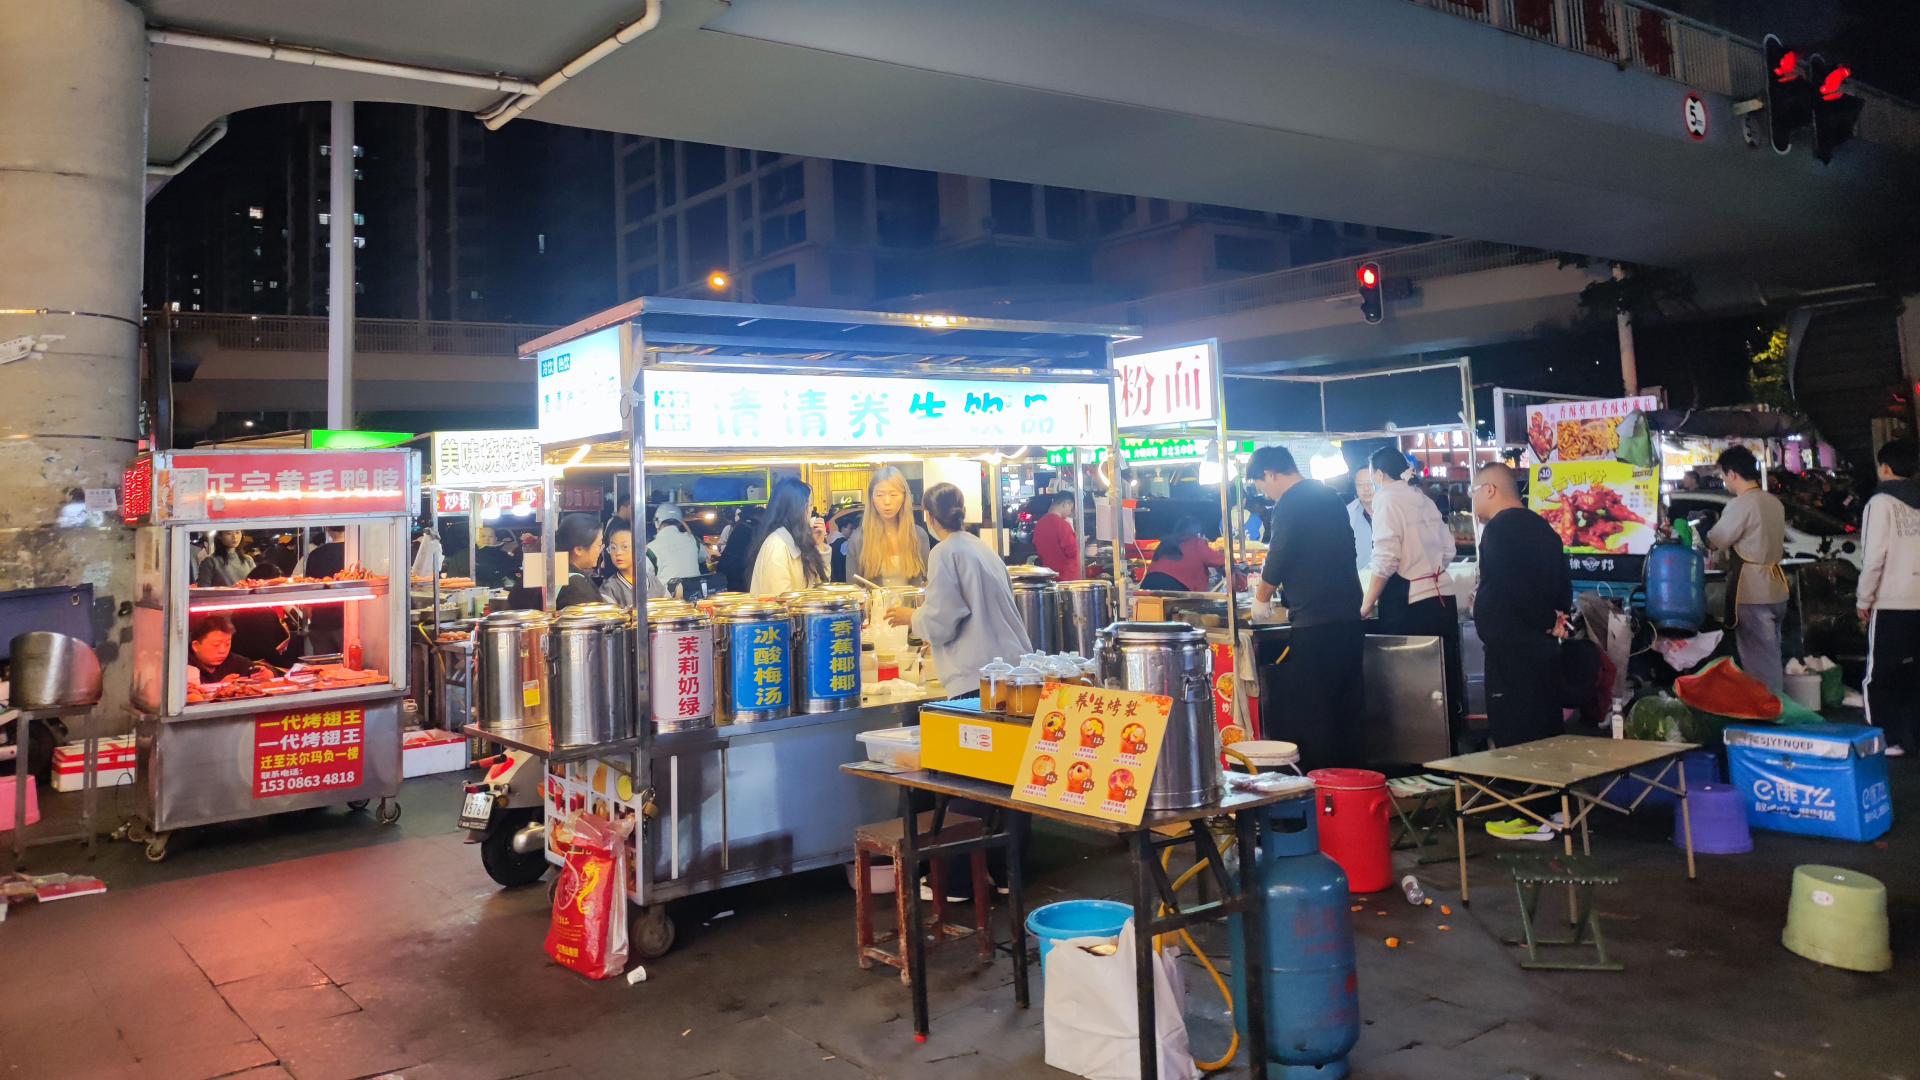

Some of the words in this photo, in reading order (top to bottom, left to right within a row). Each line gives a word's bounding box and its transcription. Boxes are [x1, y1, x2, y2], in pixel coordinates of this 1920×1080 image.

[753, 625, 783, 706] 冰酸梅汤
[829, 619, 856, 692] 香蕉椰椰
[677, 635, 701, 717] 茉莉奶绿
[1075, 691, 1139, 718] 养生烤梨
[260, 709, 362, 731] 一代烤翅王
[258, 728, 361, 751] 一代烤翅王
[260, 746, 360, 769] 迁至沃尔玛负一楼
[260, 778, 285, 793] 153
[287, 775, 321, 789] 0863
[323, 771, 355, 785] 4818
